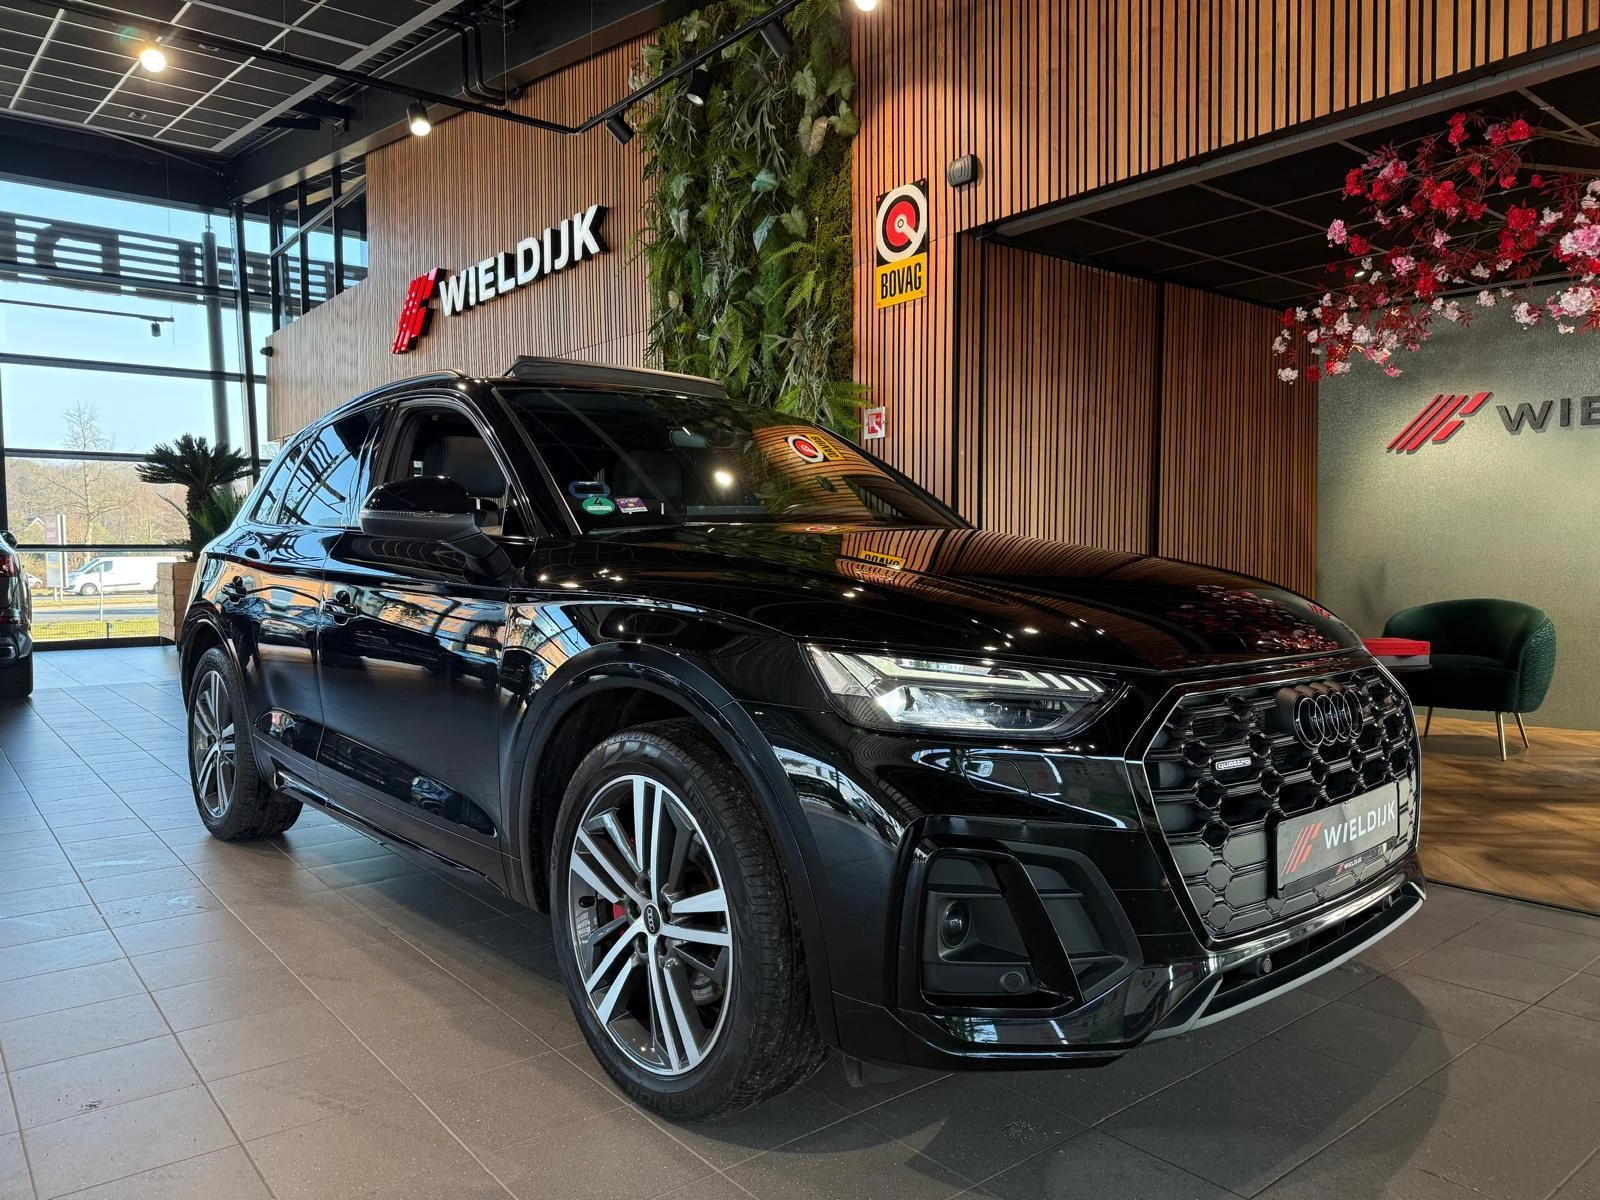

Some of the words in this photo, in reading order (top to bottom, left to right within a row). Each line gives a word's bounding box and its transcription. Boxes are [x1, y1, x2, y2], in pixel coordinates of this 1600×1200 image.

[438, 203, 602, 317] WIELDIJK
[880, 262, 922, 300] BOVAG
[1323, 799, 1396, 850] WIELDIJK
